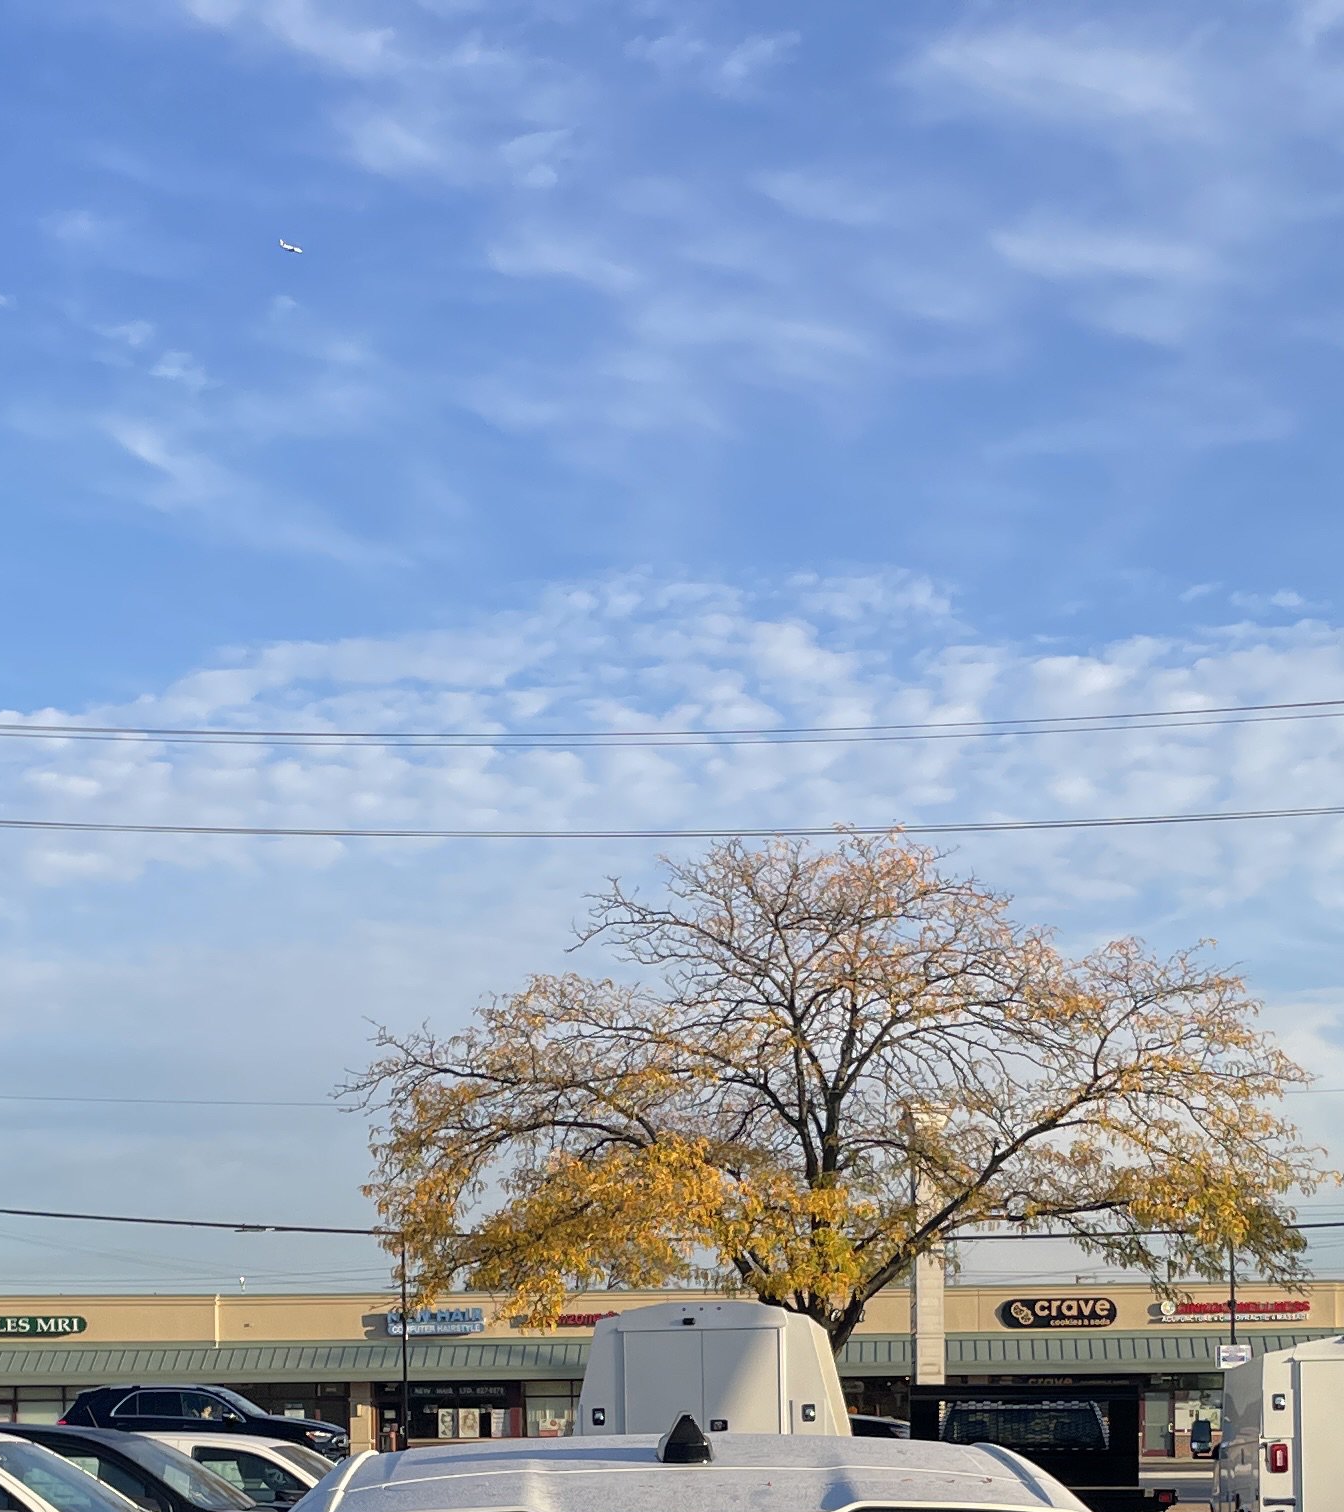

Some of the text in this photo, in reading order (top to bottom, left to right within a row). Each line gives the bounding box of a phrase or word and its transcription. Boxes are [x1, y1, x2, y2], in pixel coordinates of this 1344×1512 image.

[436, 1308, 481, 1322] HAIR
[1034, 1299, 1110, 1317] crave
[1050, 1318, 1083, 1327] cookies
[1219, 1313, 1269, 1322] CHIOPRACTIC
[36, 1317, 80, 1333] MRI
